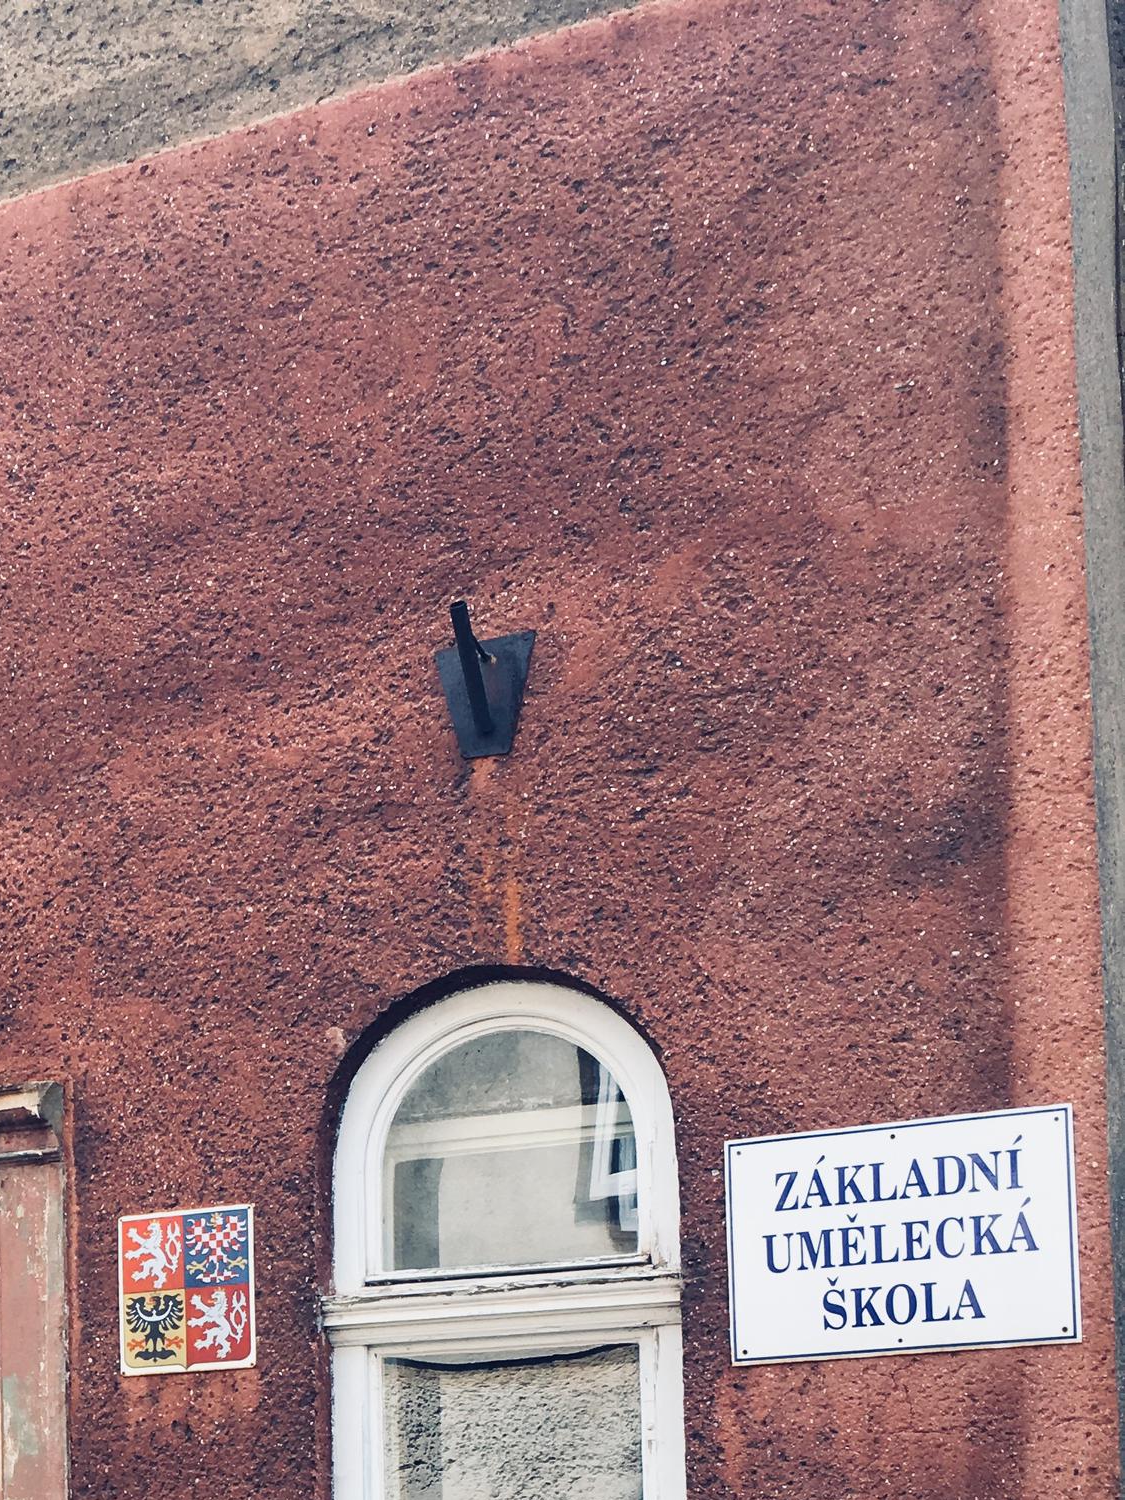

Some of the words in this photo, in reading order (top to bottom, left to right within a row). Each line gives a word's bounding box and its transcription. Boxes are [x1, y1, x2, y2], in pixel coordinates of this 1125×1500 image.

[775, 1135, 1023, 1212] ZÁKLADNÍ
[762, 1197, 1039, 1274] UMĚLECKÁ
[822, 1277, 986, 1331] ŠKOLA
